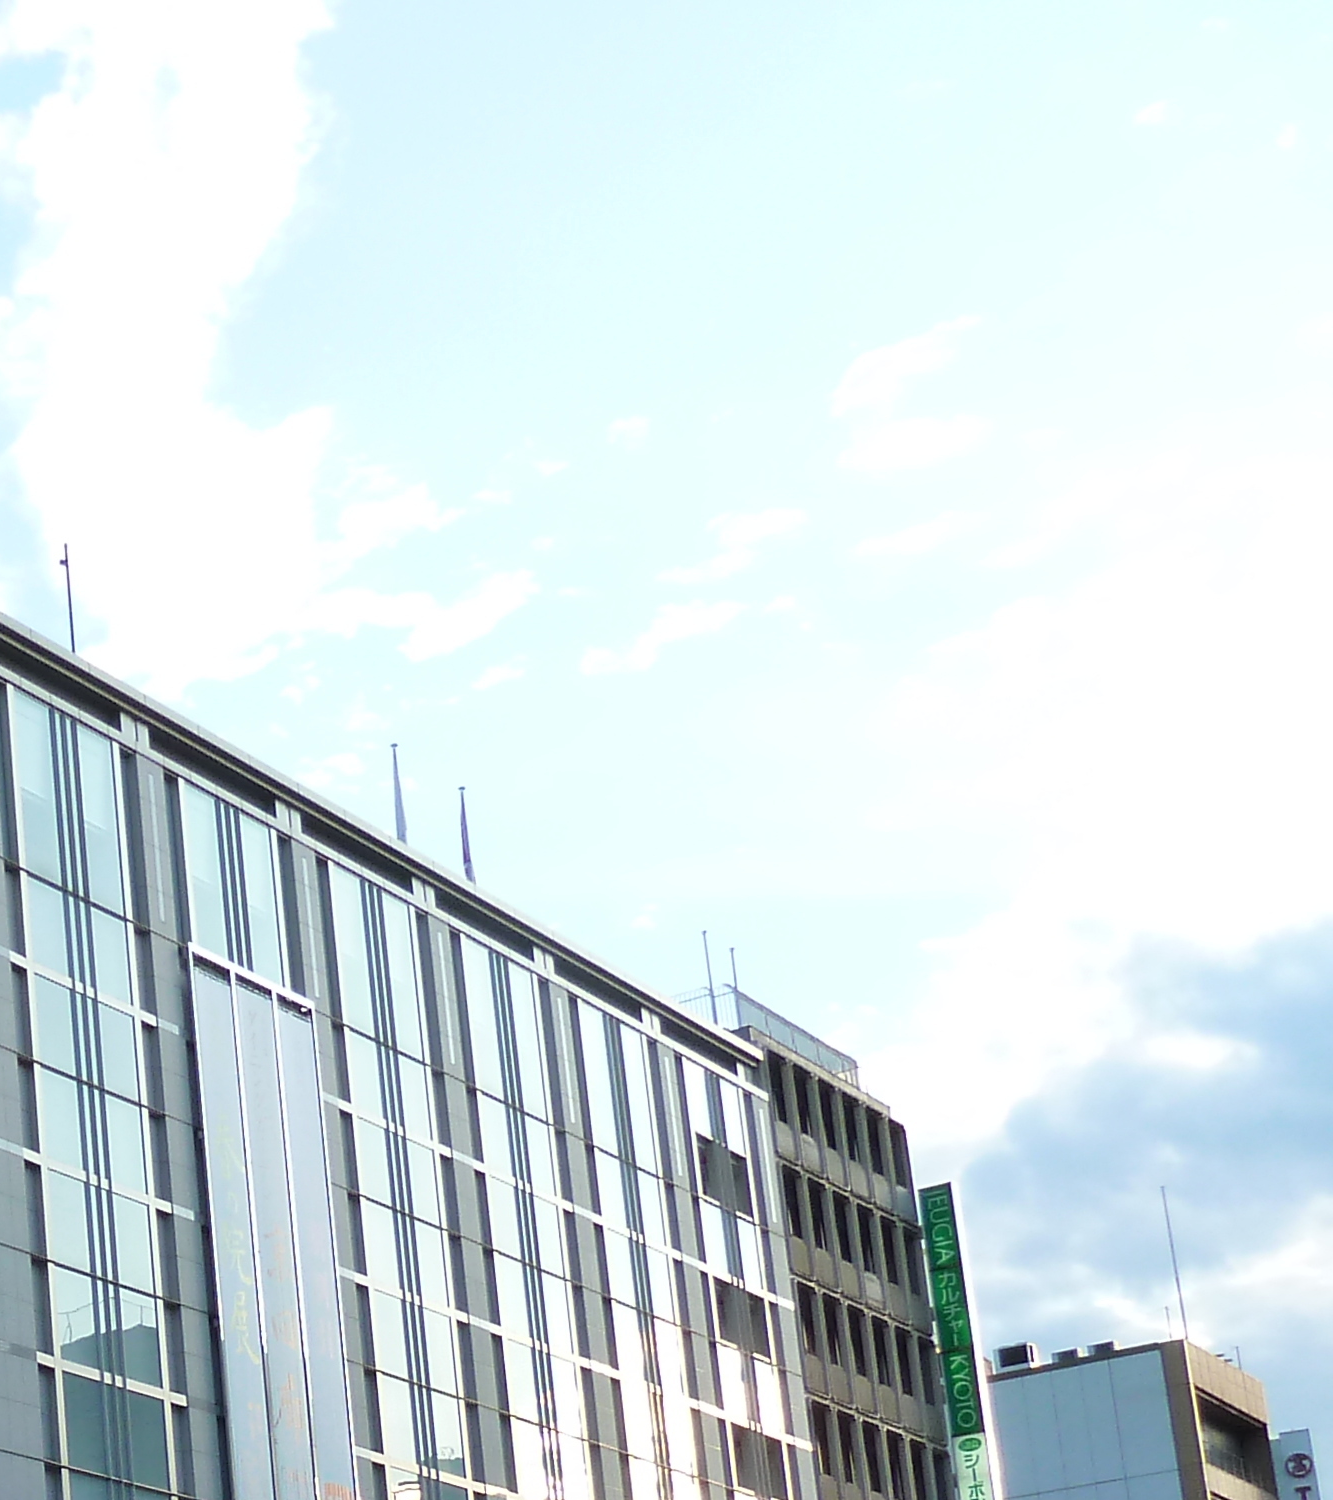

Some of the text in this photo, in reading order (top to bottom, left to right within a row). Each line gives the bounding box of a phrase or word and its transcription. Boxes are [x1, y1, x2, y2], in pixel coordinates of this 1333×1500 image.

[939, 1272, 964, 1346] カルチャー
[950, 1353, 976, 1428] KYOTO
